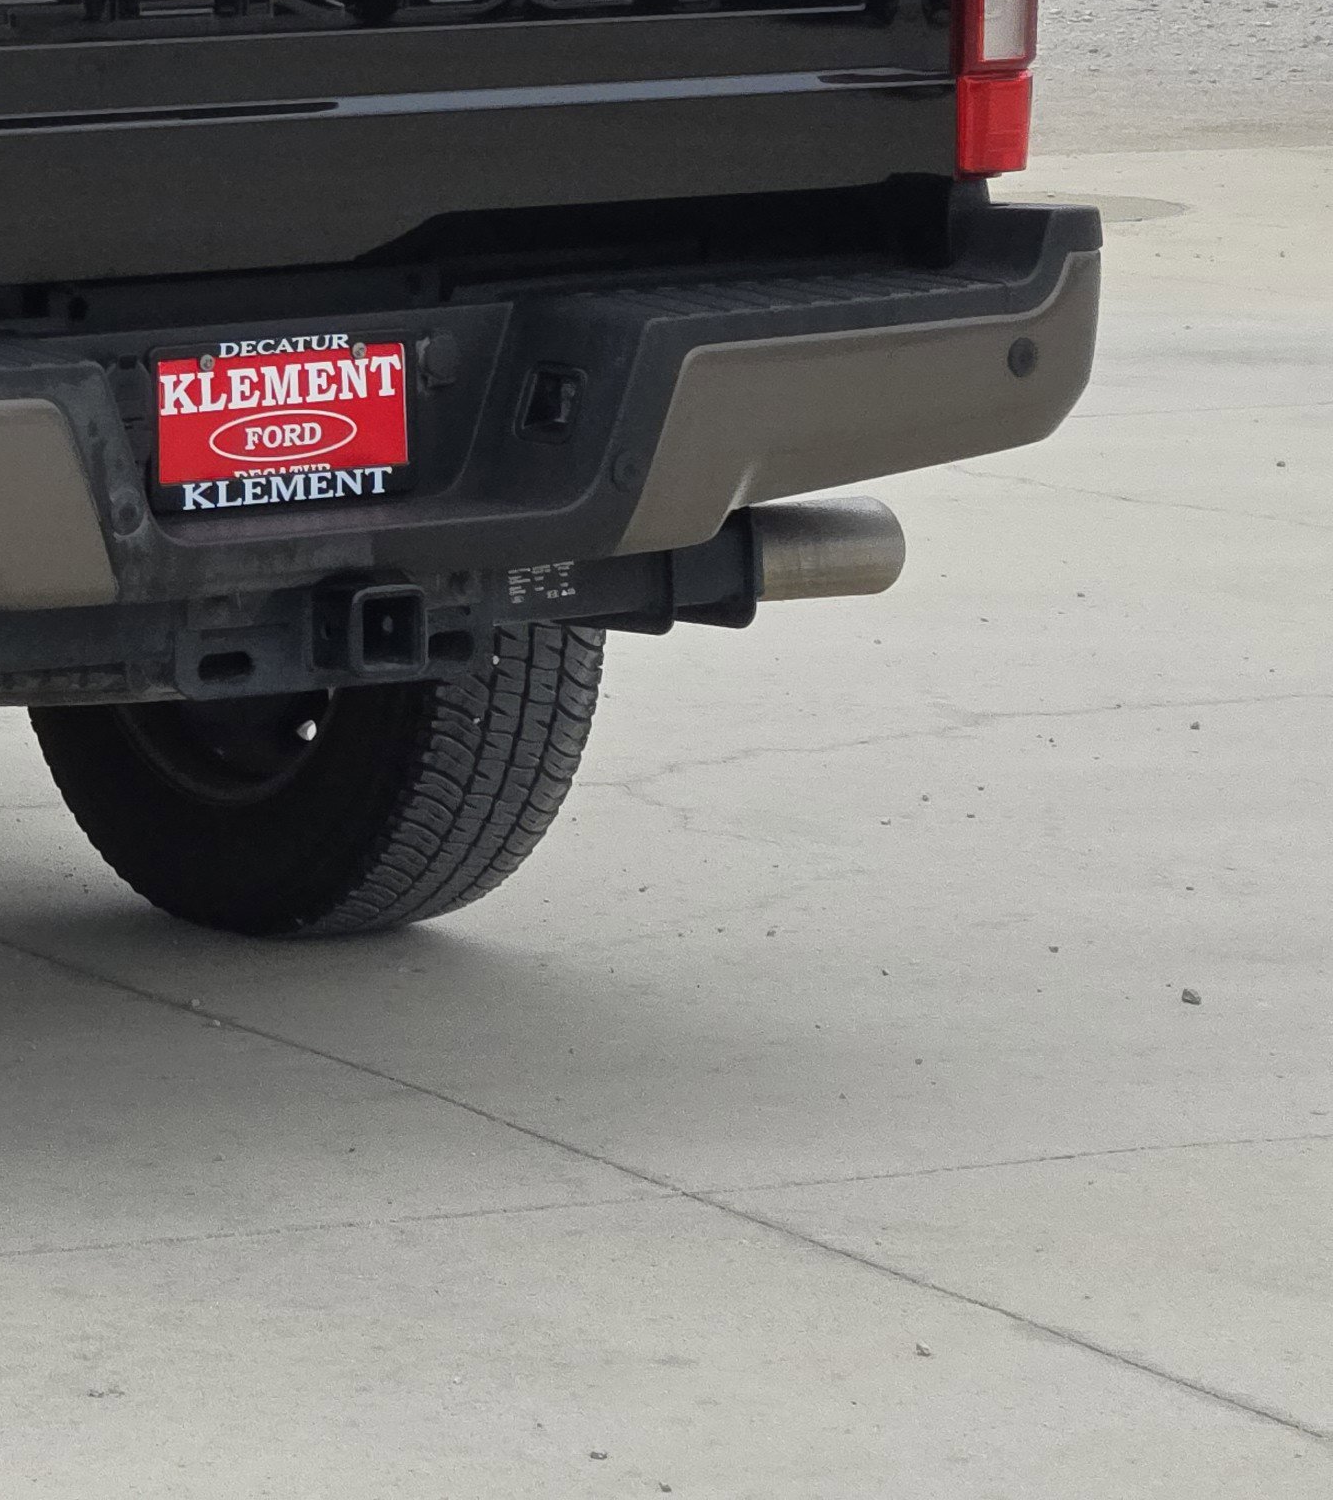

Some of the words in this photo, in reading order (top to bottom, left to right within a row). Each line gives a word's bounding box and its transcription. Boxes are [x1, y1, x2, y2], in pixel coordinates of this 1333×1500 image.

[219, 333, 349, 358] DECATUR
[159, 354, 402, 416] KLEMENT
[244, 422, 322, 450] FORD
[182, 466, 393, 511] KLEMENT
